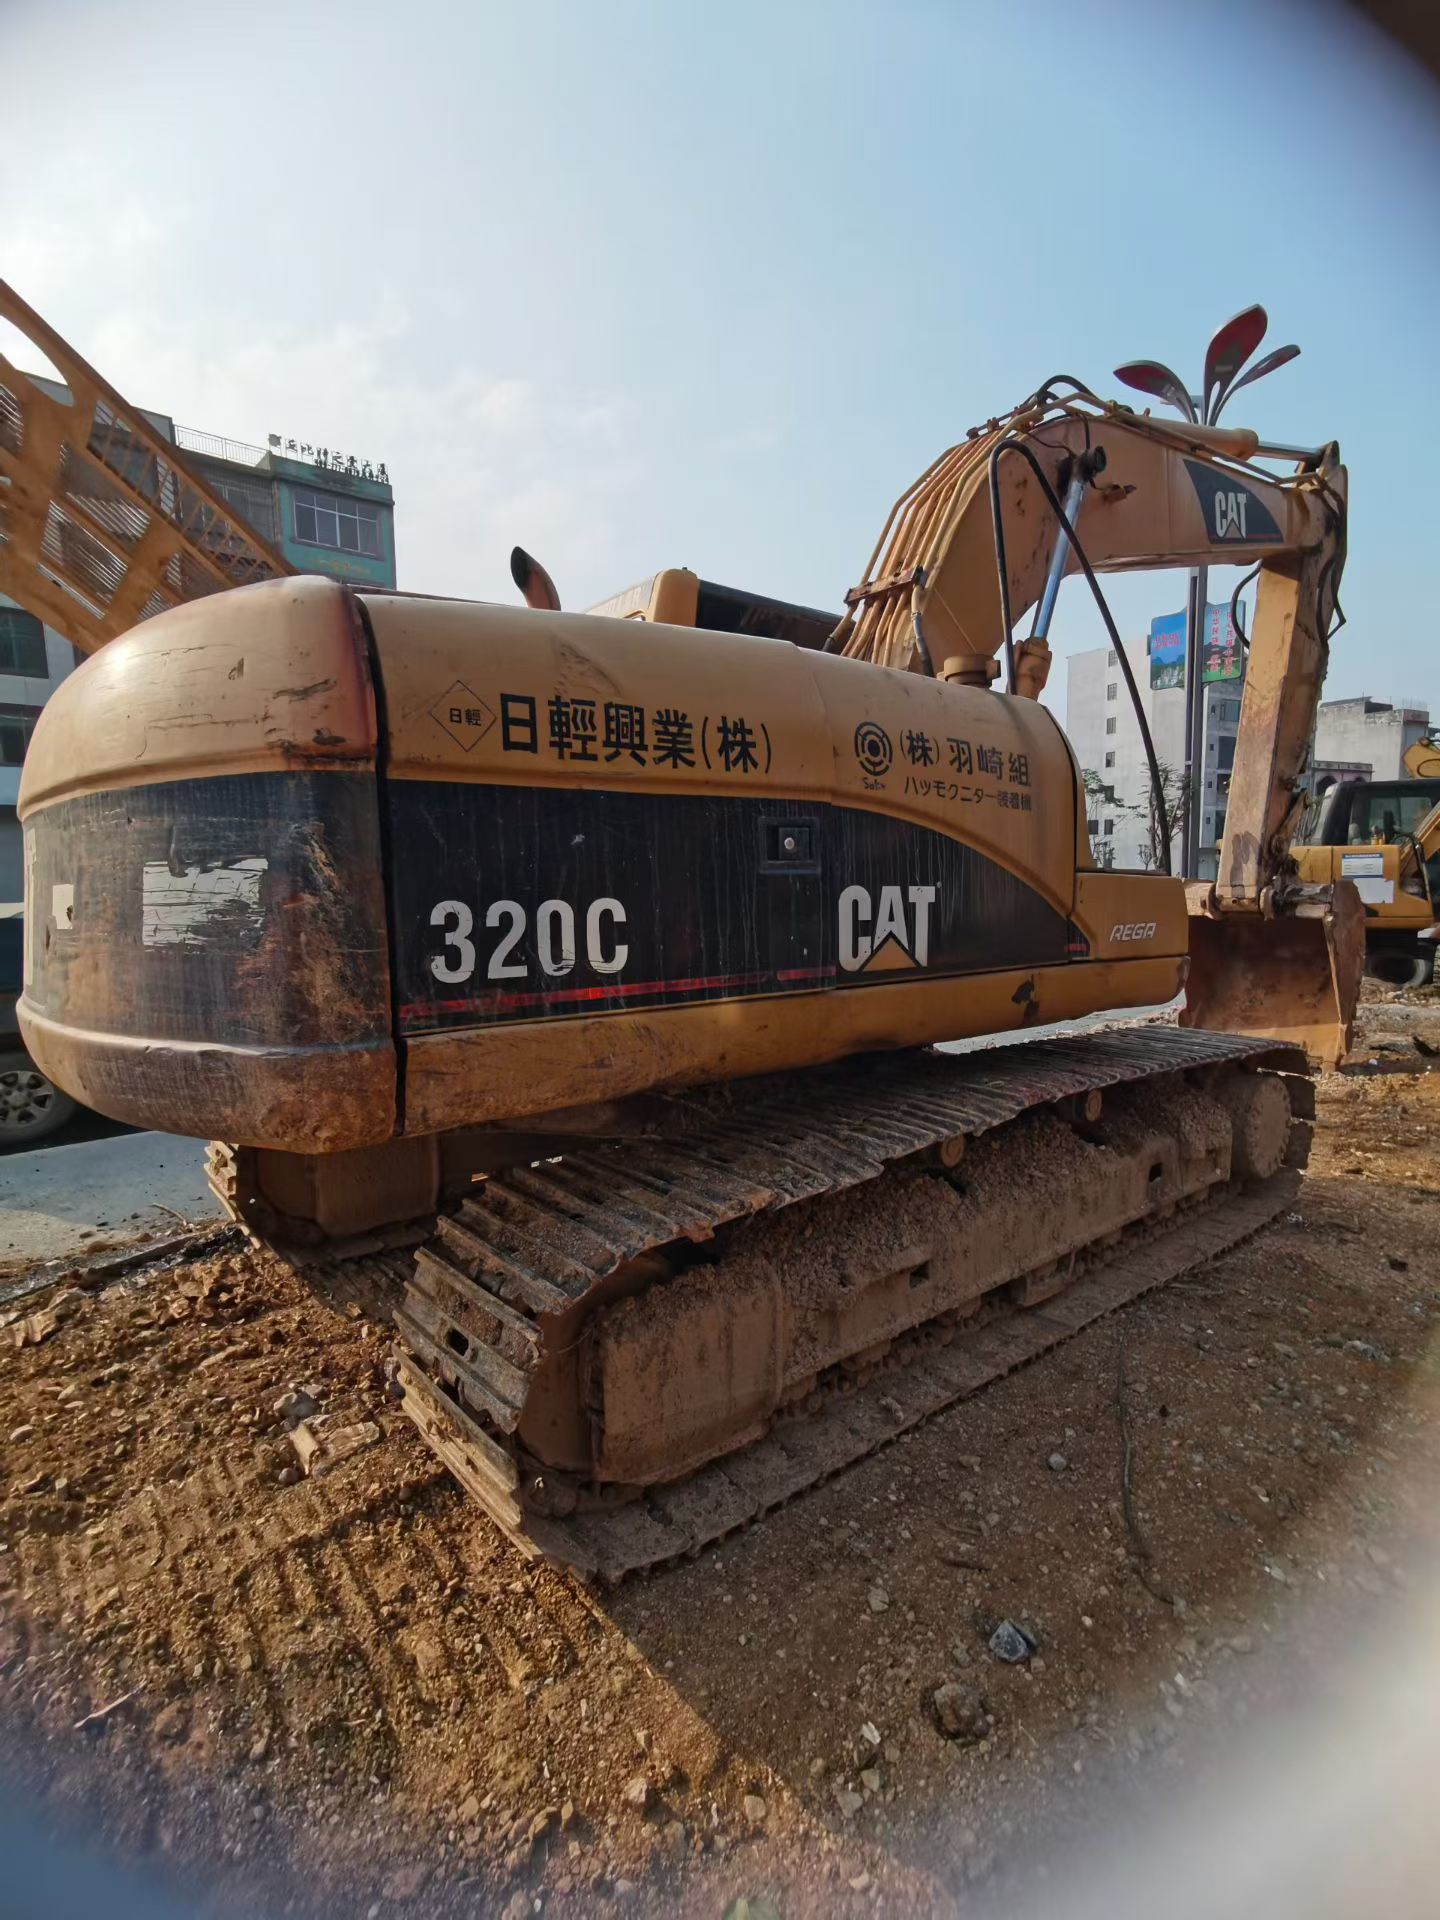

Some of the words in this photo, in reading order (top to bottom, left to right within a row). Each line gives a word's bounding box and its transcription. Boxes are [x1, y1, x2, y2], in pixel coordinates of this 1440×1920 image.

[1215, 491, 1248, 538] CAT
[430, 898, 628, 984] 320C
[838, 885, 935, 972] CAT
